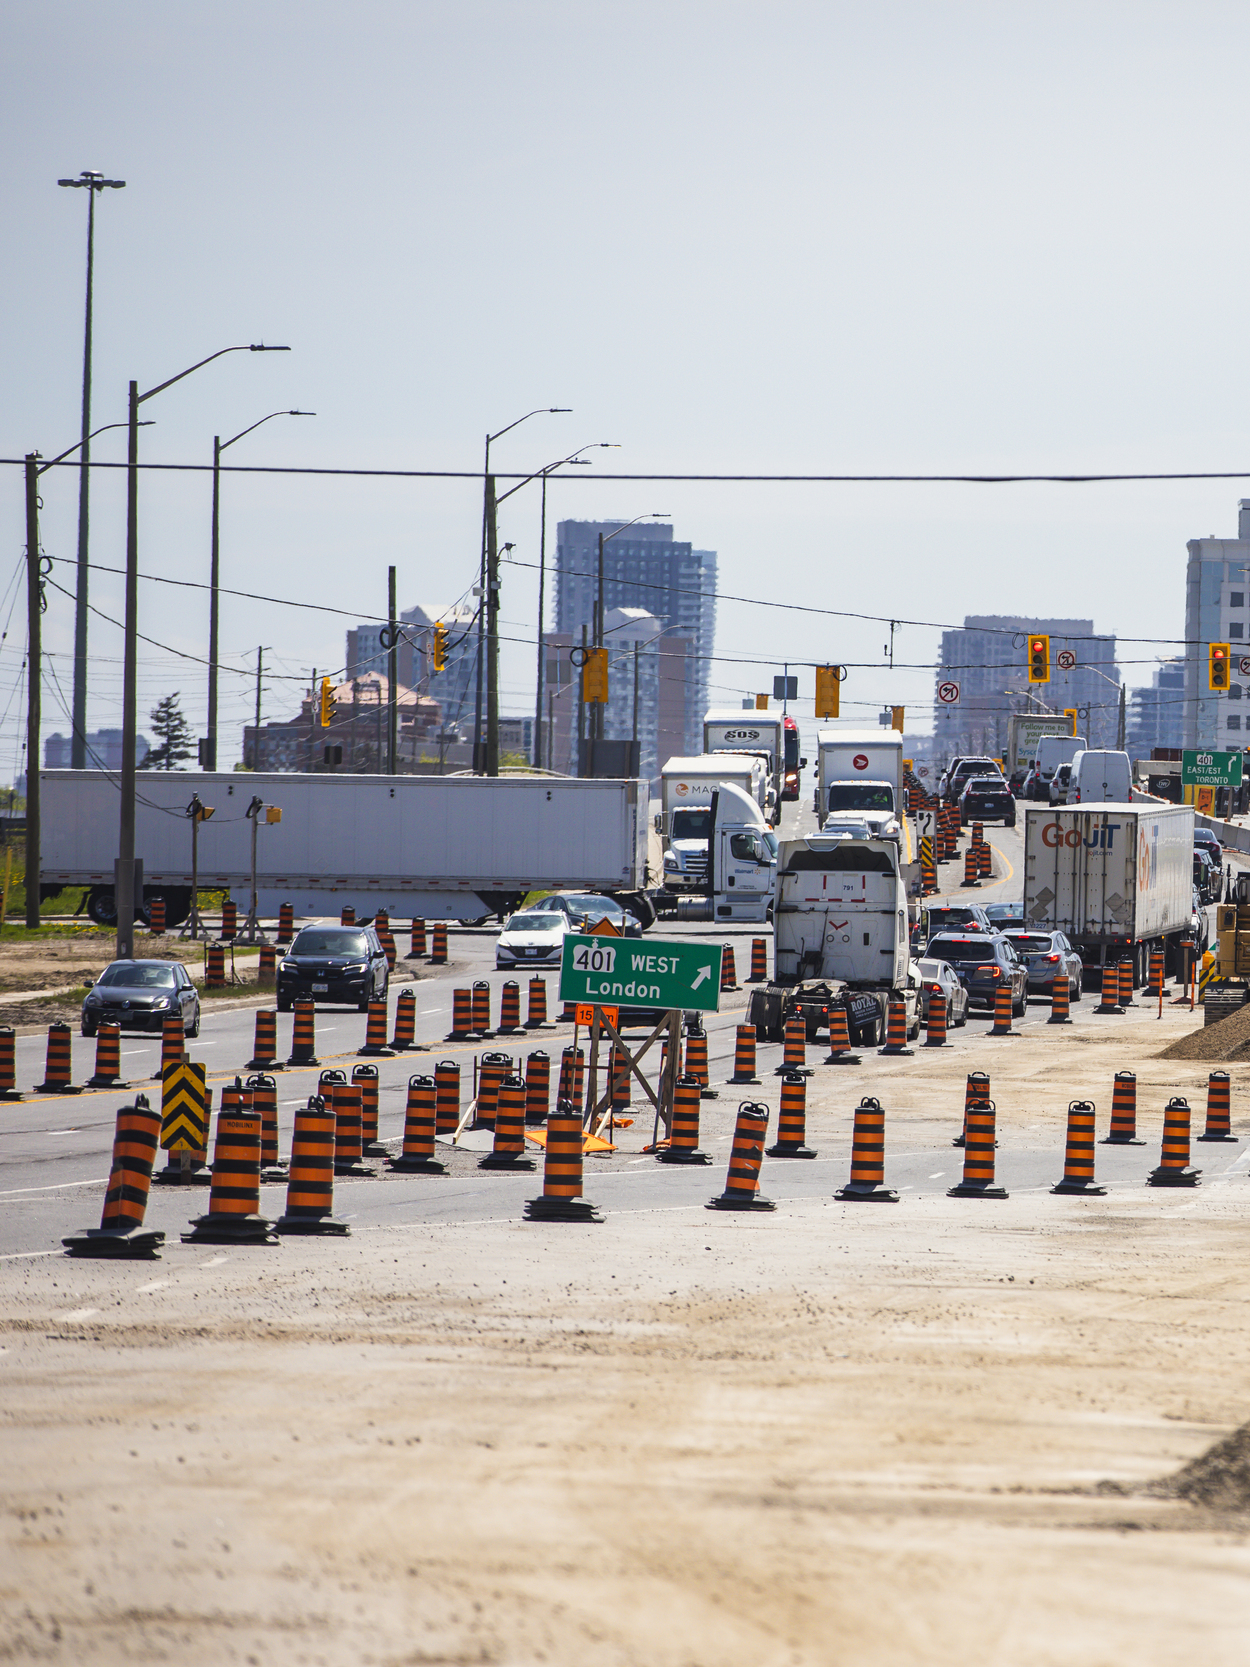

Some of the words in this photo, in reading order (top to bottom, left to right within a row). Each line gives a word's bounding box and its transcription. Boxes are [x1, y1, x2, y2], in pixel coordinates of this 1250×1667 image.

[726, 730, 758, 739] SOS
[1198, 756, 1212, 765] 401
[1187, 766, 1222, 774] EAST/EST
[1196, 776, 1229, 784] TORONTO
[692, 786, 718, 794] MAG
[576, 950, 612, 972] 401
[631, 954, 680, 974] WEST
[586, 977, 660, 999] London
[850, 998, 877, 1012] ROYAL
[580, 1010, 592, 1021] 15
[226, 1121, 254, 1129] MOBILINX
